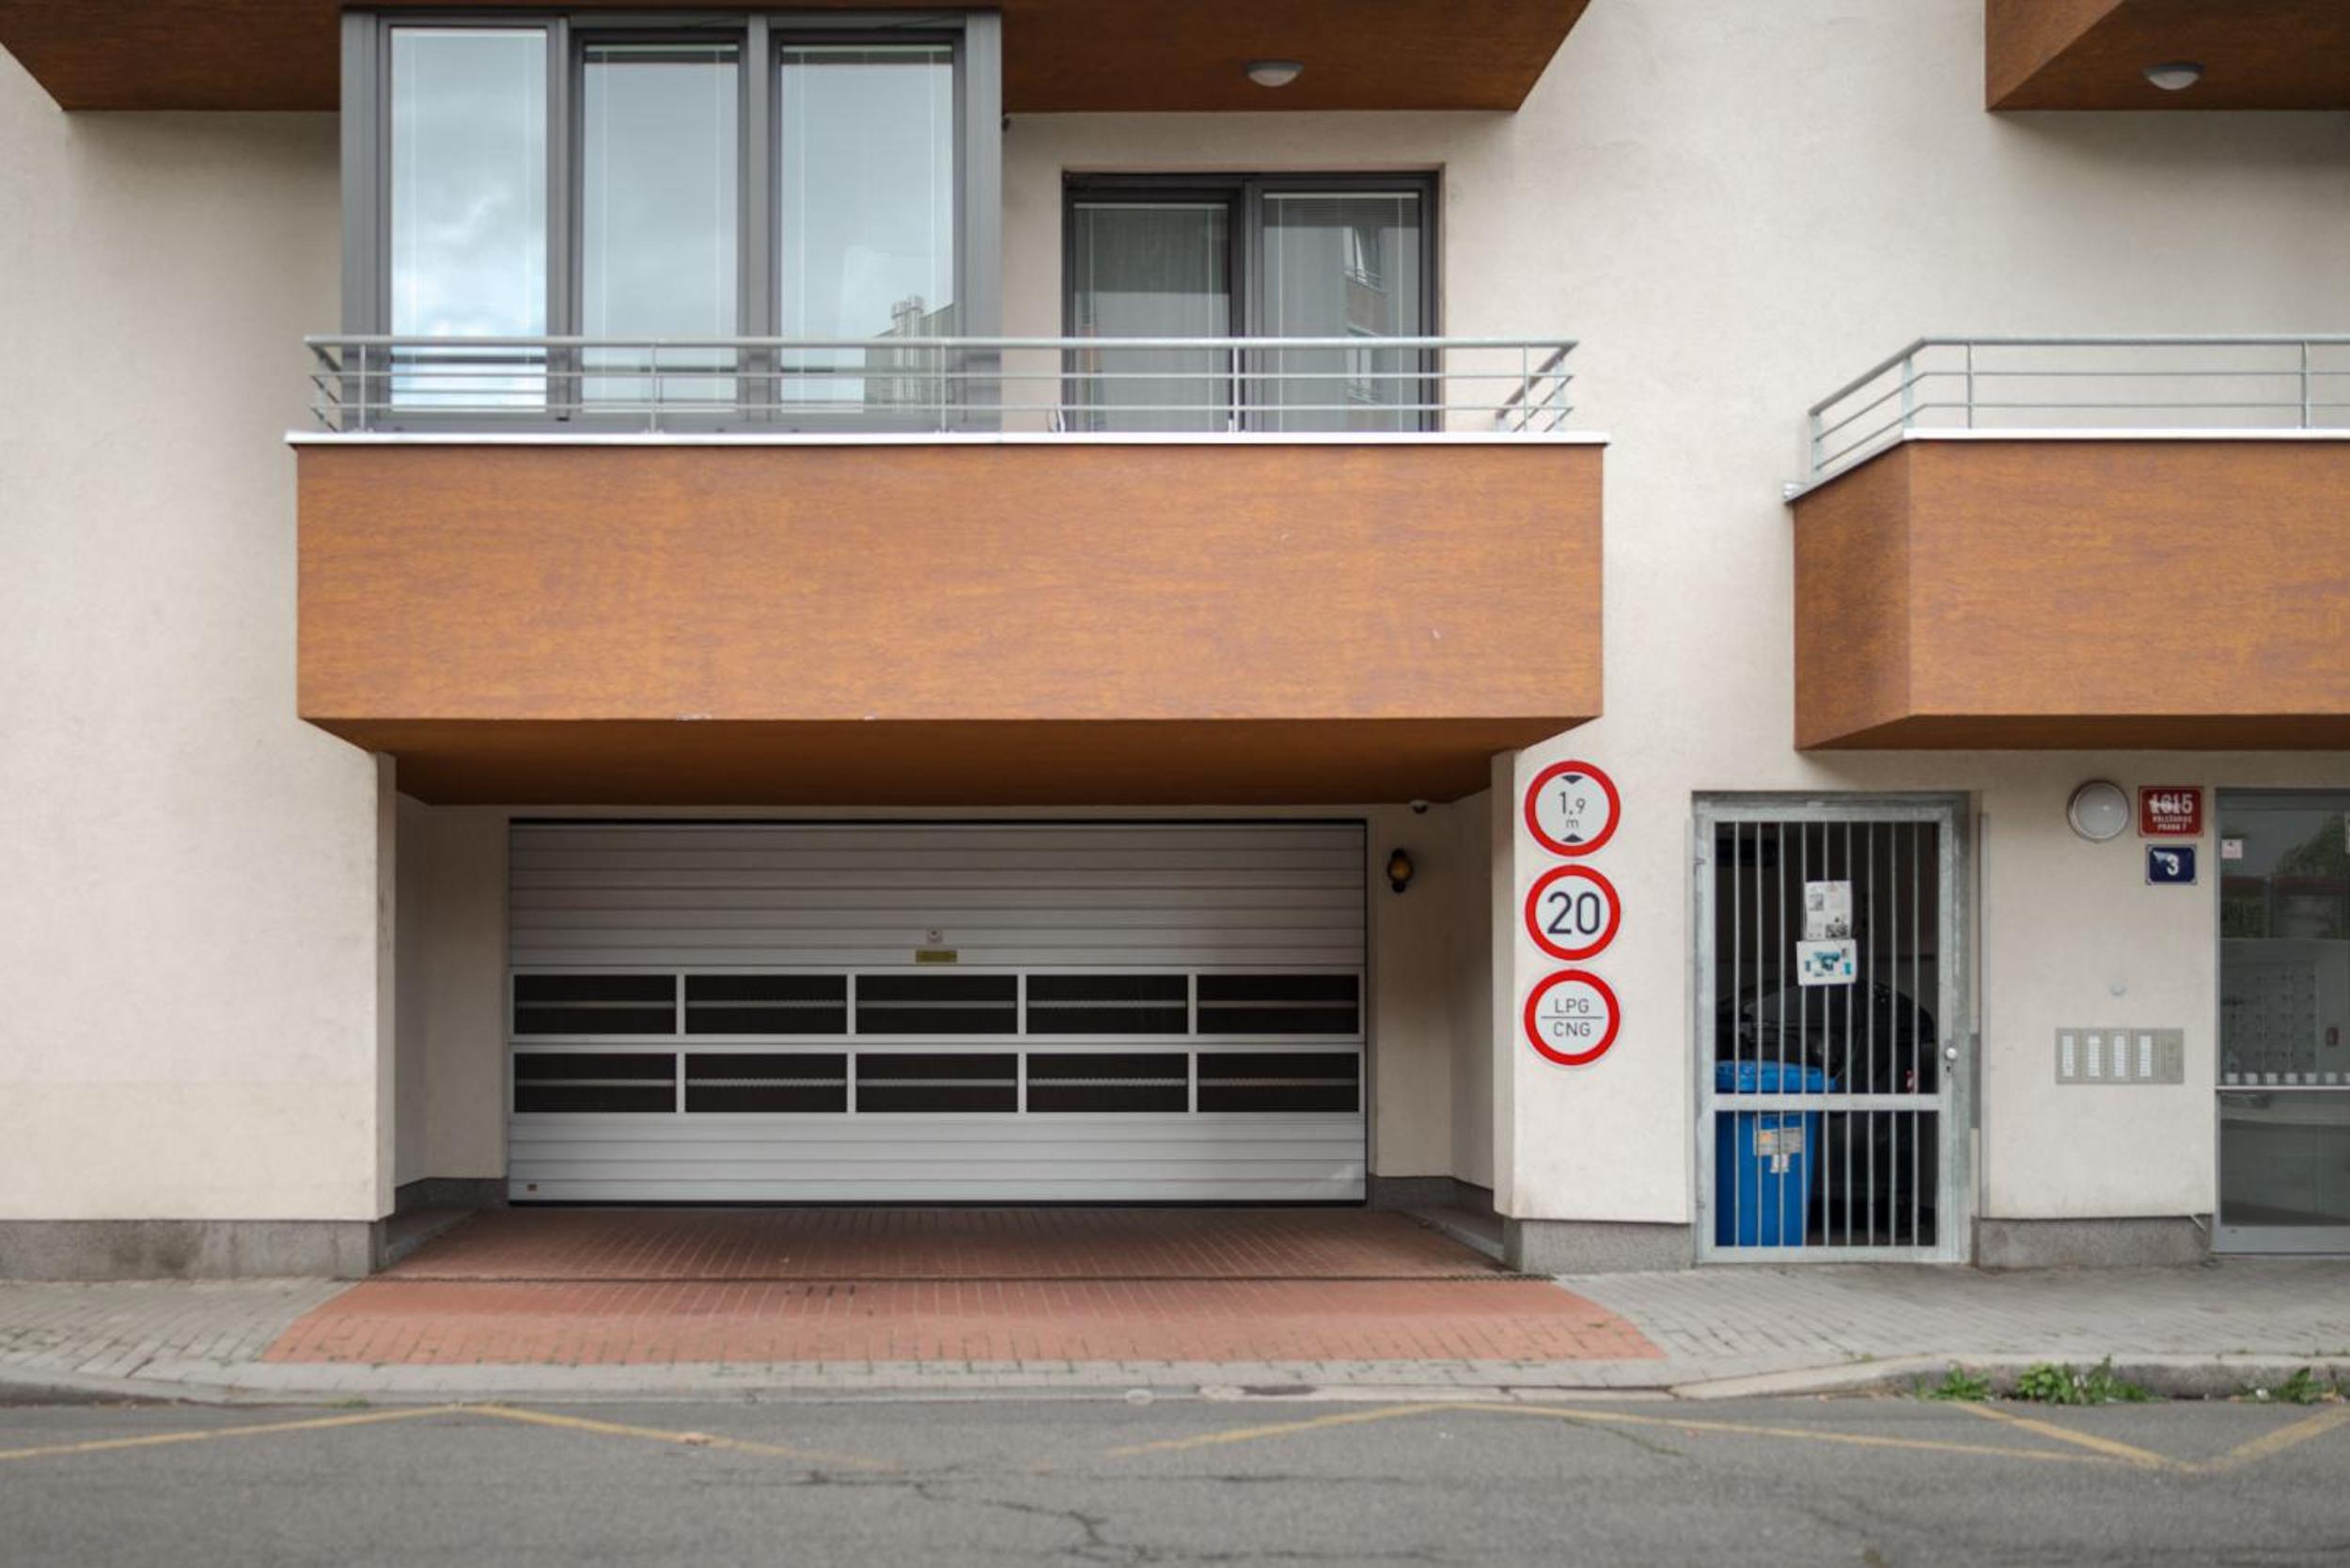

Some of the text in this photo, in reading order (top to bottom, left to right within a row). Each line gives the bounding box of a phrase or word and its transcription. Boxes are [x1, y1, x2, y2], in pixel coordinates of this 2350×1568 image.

[1565, 819, 1580, 829] m
[2166, 854, 2180, 876] 3
[1547, 891, 1601, 935] 20
[1555, 998, 1590, 1014] LPG
[1553, 1022, 1591, 1038] CNG
